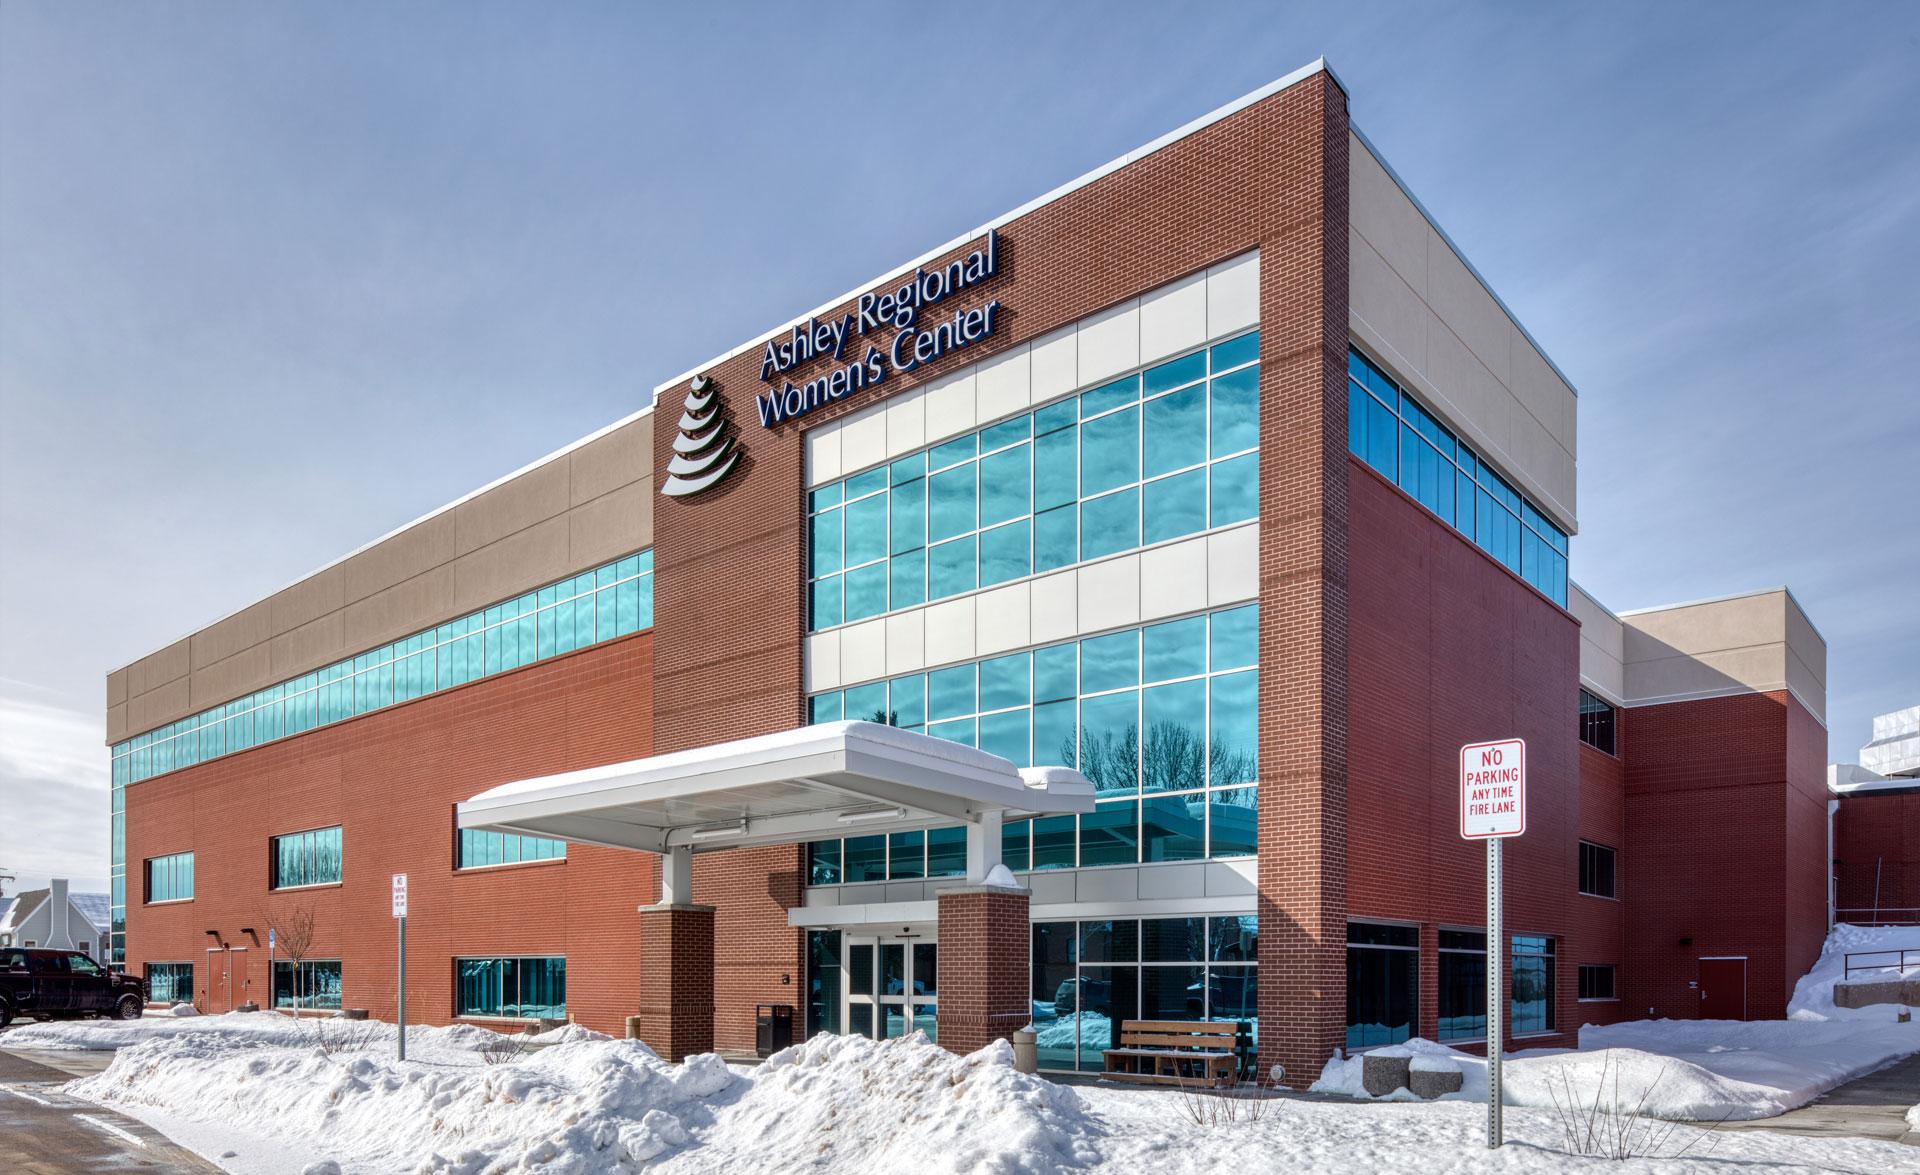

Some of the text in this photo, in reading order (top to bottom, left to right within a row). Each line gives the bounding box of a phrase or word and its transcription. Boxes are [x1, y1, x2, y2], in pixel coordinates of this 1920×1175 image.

[759, 228, 997, 381] Ashley Regional
[756, 301, 1000, 428] Women's Center
[1482, 750, 1502, 767] NO
[1467, 768, 1518, 786] PARKING
[1472, 786, 1513, 800] ANY TIME
[1470, 801, 1515, 815] FIRE LANE
